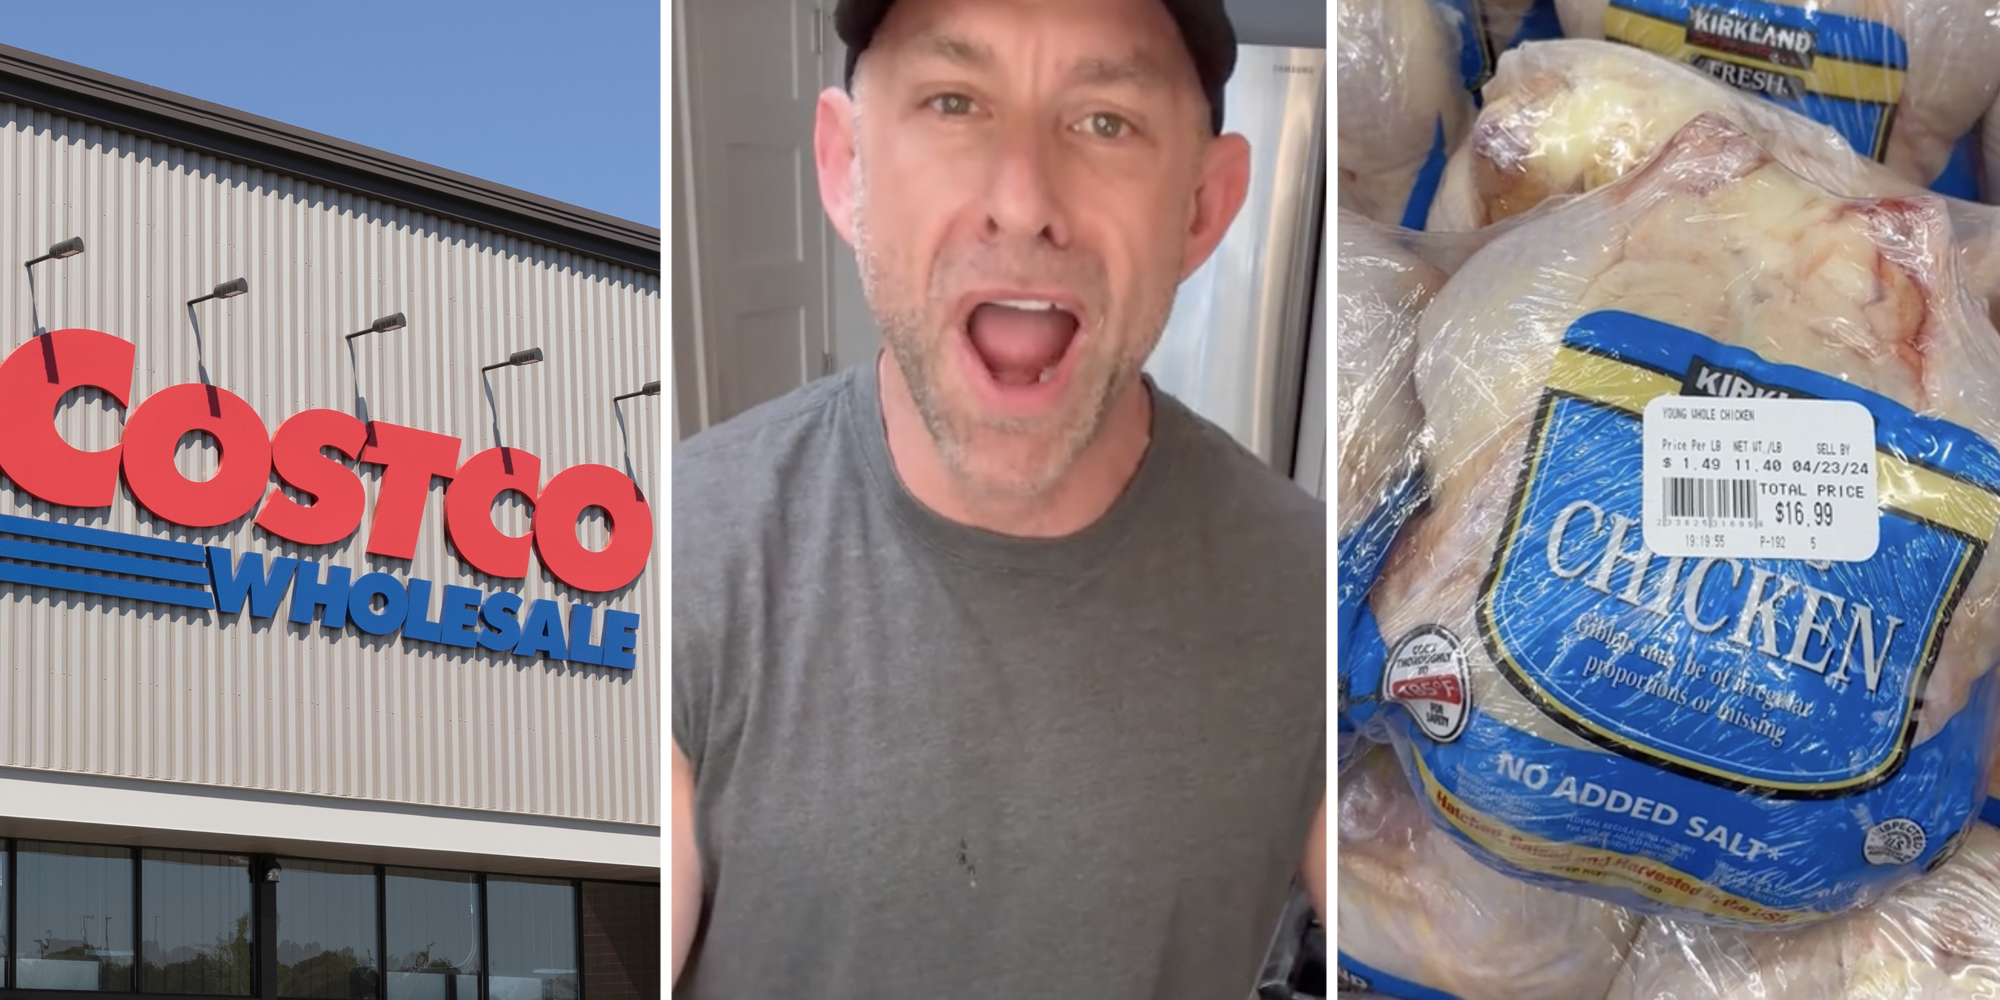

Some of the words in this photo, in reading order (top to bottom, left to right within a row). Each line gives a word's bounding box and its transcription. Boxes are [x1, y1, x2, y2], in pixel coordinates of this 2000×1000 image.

[1694, 12, 1813, 54] KIRKLAND
[1662, 407, 1687, 420] YOUNG
[1691, 408, 1716, 420] WHOLE
[1720, 409, 1755, 421] CHICKEN
[1662, 438, 1687, 451] Price
[1691, 440, 1706, 452] Per
[1711, 440, 1721, 452] LB
[1733, 441, 1748, 453] NET
[1816, 443, 1836, 455] SELL
[1840, 444, 1851, 455] BY
[0, 328, 654, 592] COSTCO
[1662, 457, 1672, 469] $
[1684, 457, 1721, 471] 1.49
[1735, 459, 1782, 472] 11.40
[1793, 461, 1869, 475] 04/23/24
[1759, 482, 1807, 497] TOTAL
[1817, 485, 1865, 499] PRICE
[1775, 501, 1834, 528] $16.99
[1685, 535, 1726, 548] 19:19:55
[1760, 536, 1786, 549] P-192
[1810, 536, 1817, 549] 5
[205, 545, 640, 670] WHOLESALE
[1546, 500, 1904, 696] CHICKEN
[1686, 651, 1707, 681] be
[1710, 665, 1733, 690] of
[1583, 652, 1689, 707] proportions
[1693, 695, 1713, 714] or
[1717, 699, 1788, 747] missing
[1497, 751, 1550, 791] NO
[1550, 776, 1680, 826] ADDED
[1614, 857, 1702, 897] Harvested
